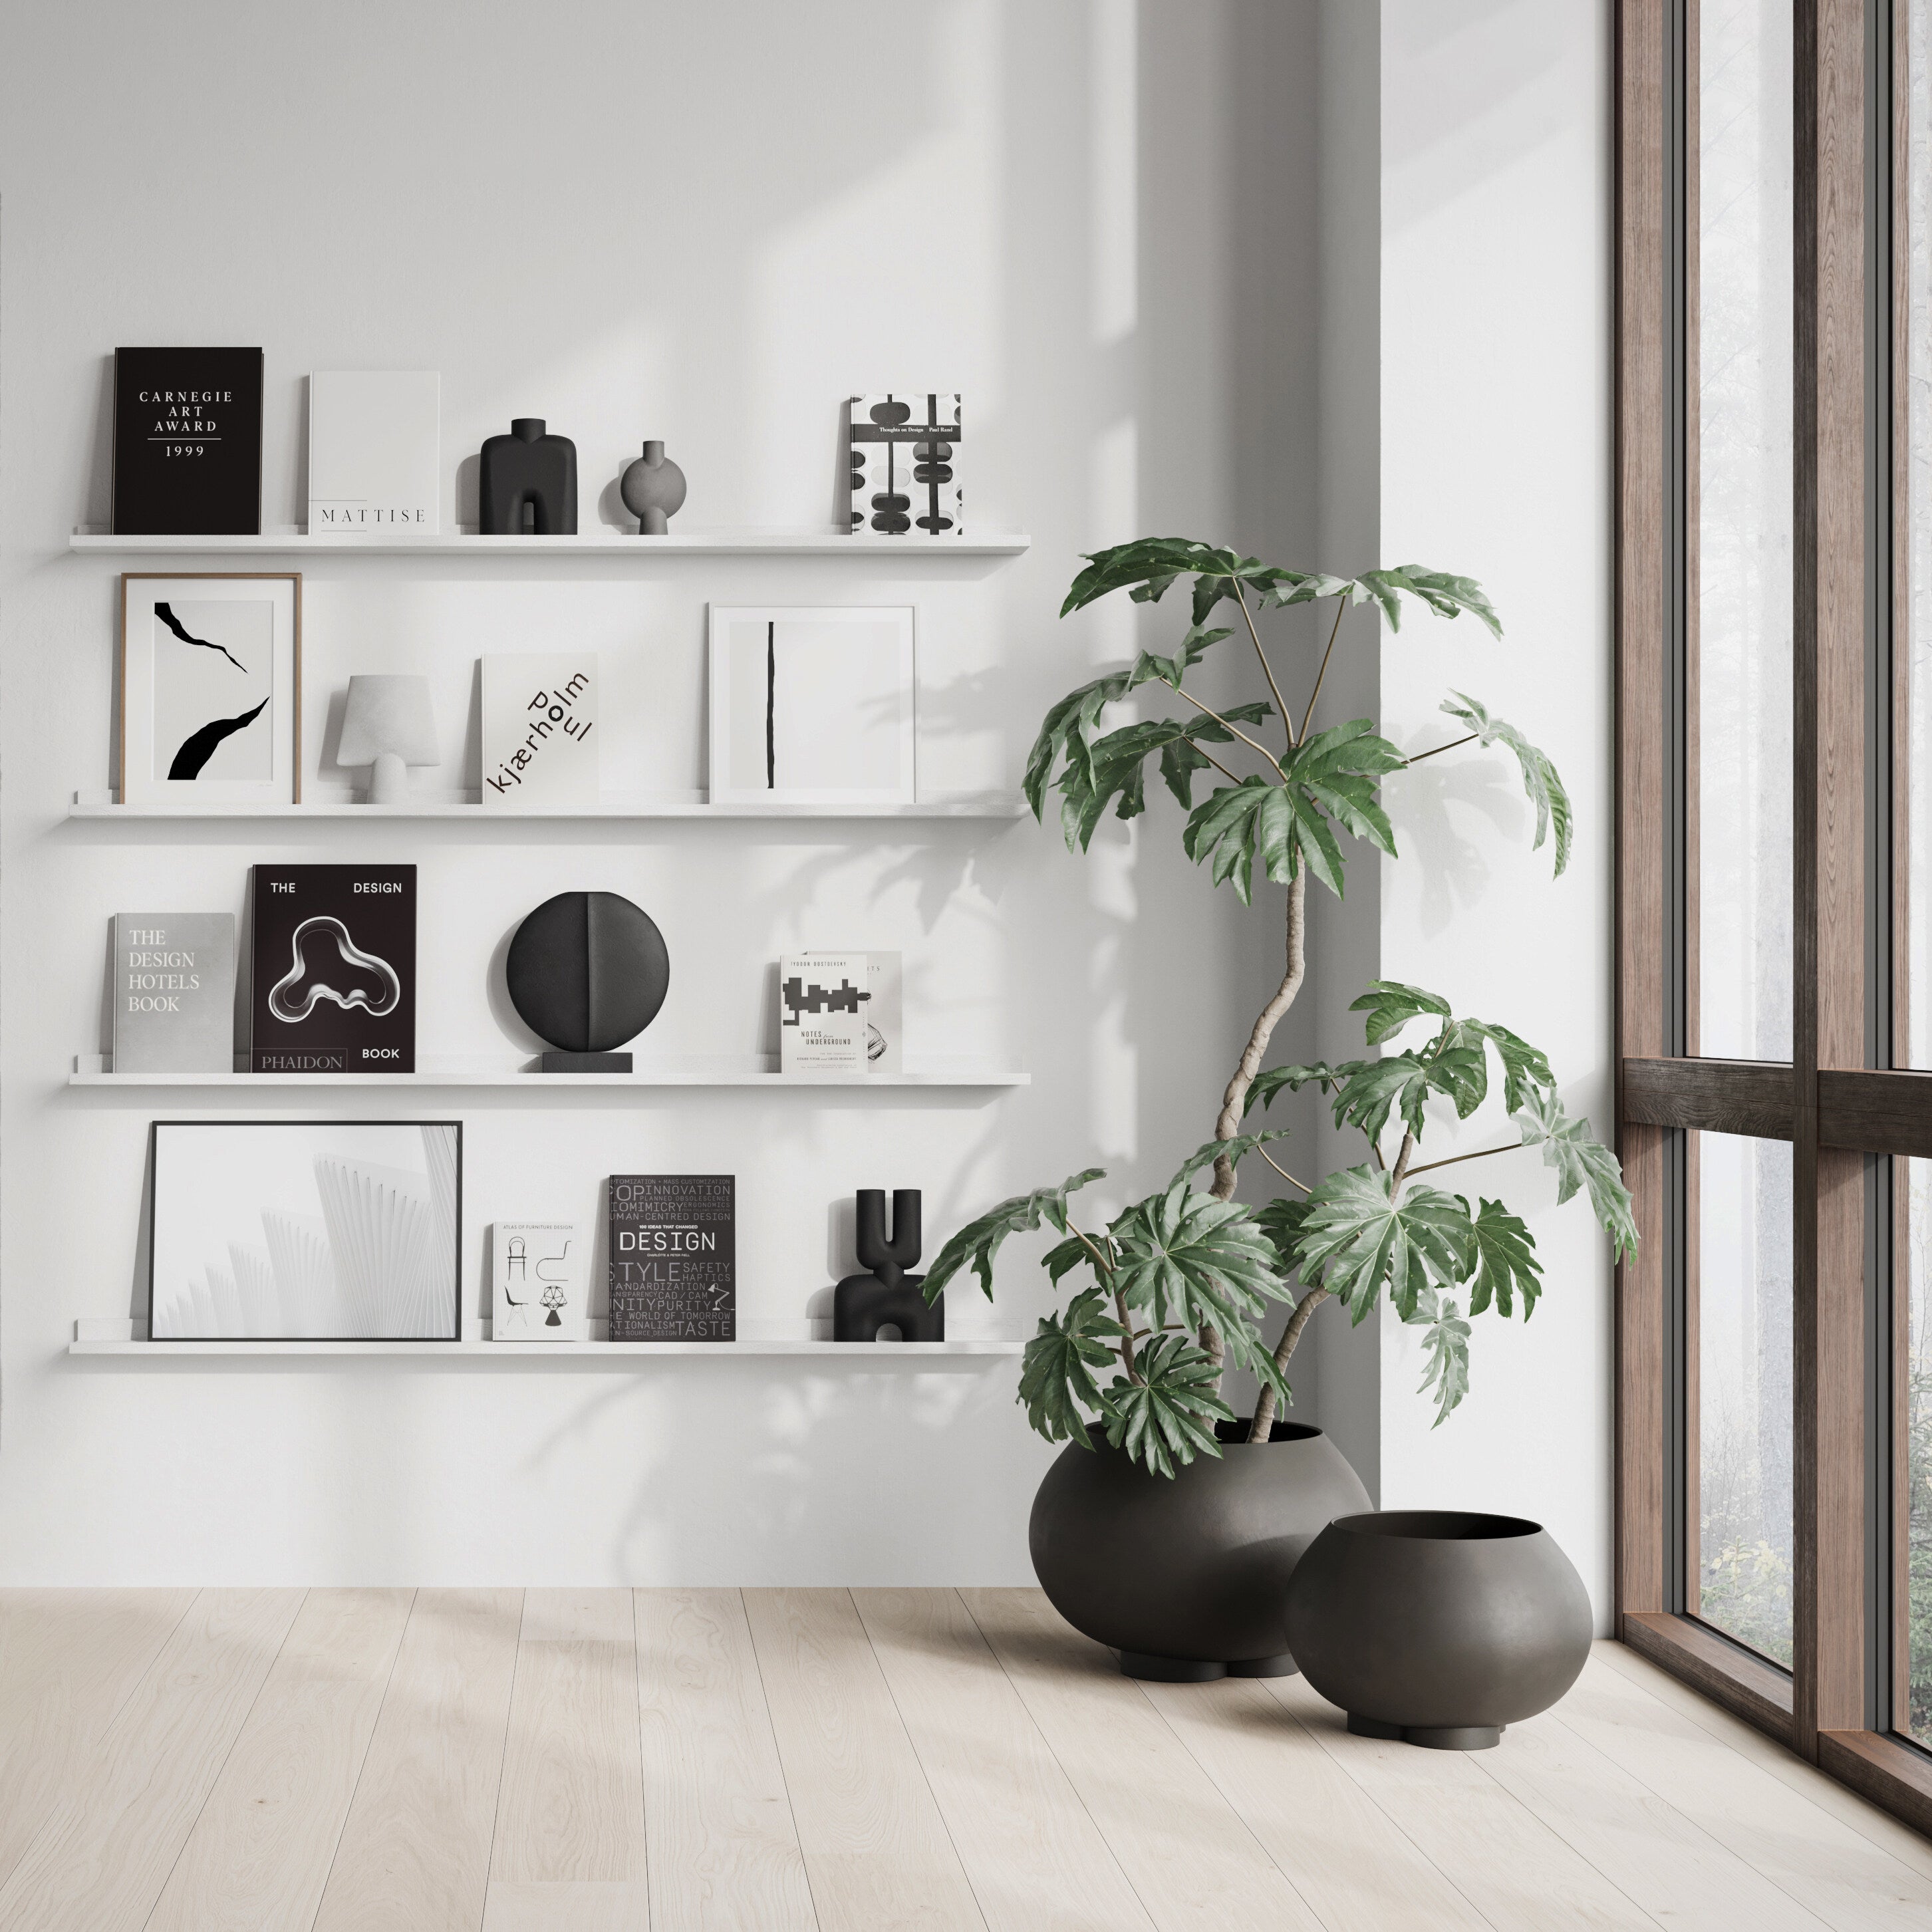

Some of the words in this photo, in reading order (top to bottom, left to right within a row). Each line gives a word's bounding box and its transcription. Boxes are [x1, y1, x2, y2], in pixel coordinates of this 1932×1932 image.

[140, 392, 231, 402] CARNEGIE
[169, 406, 202, 416] ART
[155, 422, 215, 431] AWARD
[167, 446, 203, 456] 1999
[323, 510, 424, 521] MATTISE
[271, 883, 295, 893] THE
[354, 883, 401, 893] DESIGN
[130, 930, 165, 944] THE
[130, 952, 194, 966] DESIGN
[129, 974, 199, 989] HOTELS
[129, 997, 179, 1011] BOOK
[363, 1049, 399, 1058] BOOK
[262, 1057, 342, 1068] PHAIDON
[610, 1185, 644, 1200] OP
[645, 1186, 730, 1194] INNOVATION
[620, 1232, 714, 1250] DESIGN
[683, 1263, 730, 1272] SAFETY
[658, 1300, 711, 1310] PURITY
[675, 1321, 730, 1335] TASTE
